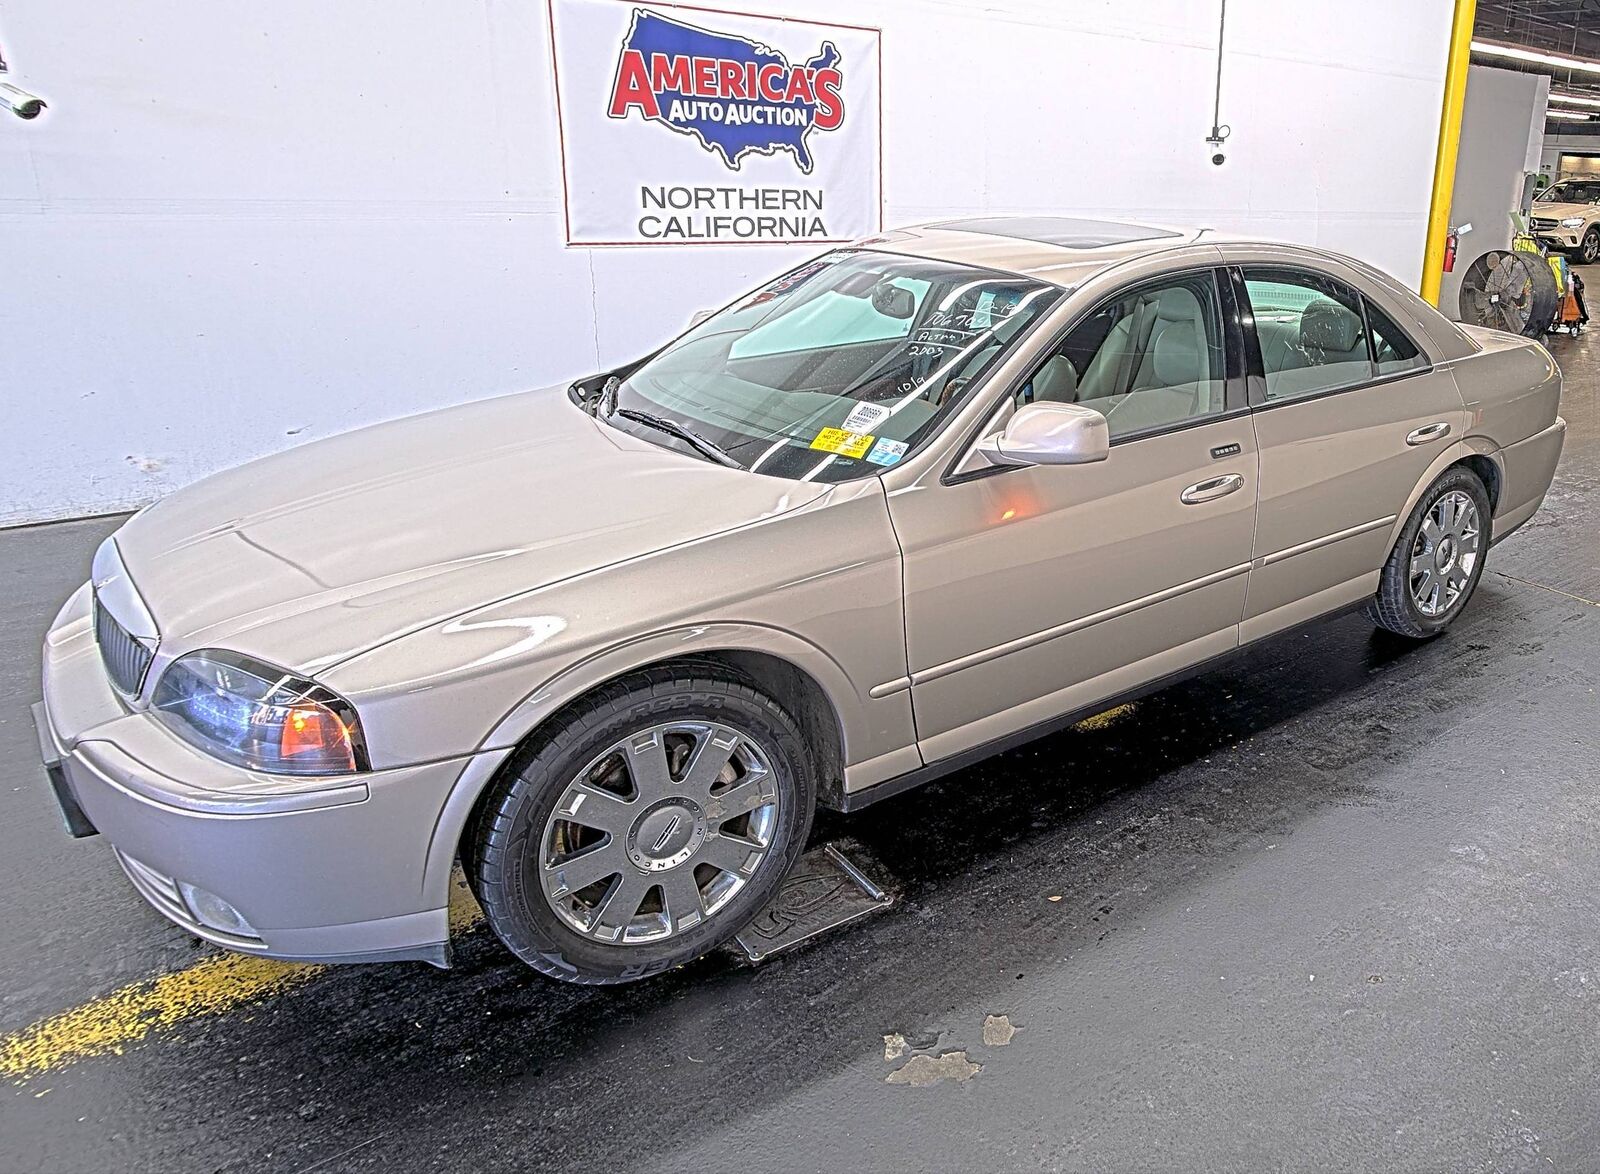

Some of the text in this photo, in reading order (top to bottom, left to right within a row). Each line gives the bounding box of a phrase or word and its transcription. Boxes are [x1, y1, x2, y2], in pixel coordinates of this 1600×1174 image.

[609, 49, 844, 129] AMERICA'S
[668, 99, 808, 127] AUTO AUCTION
[641, 186, 823, 210] NORTHERN
[638, 215, 828, 238] CALIFORNIA
[908, 345, 944, 358] 2003
